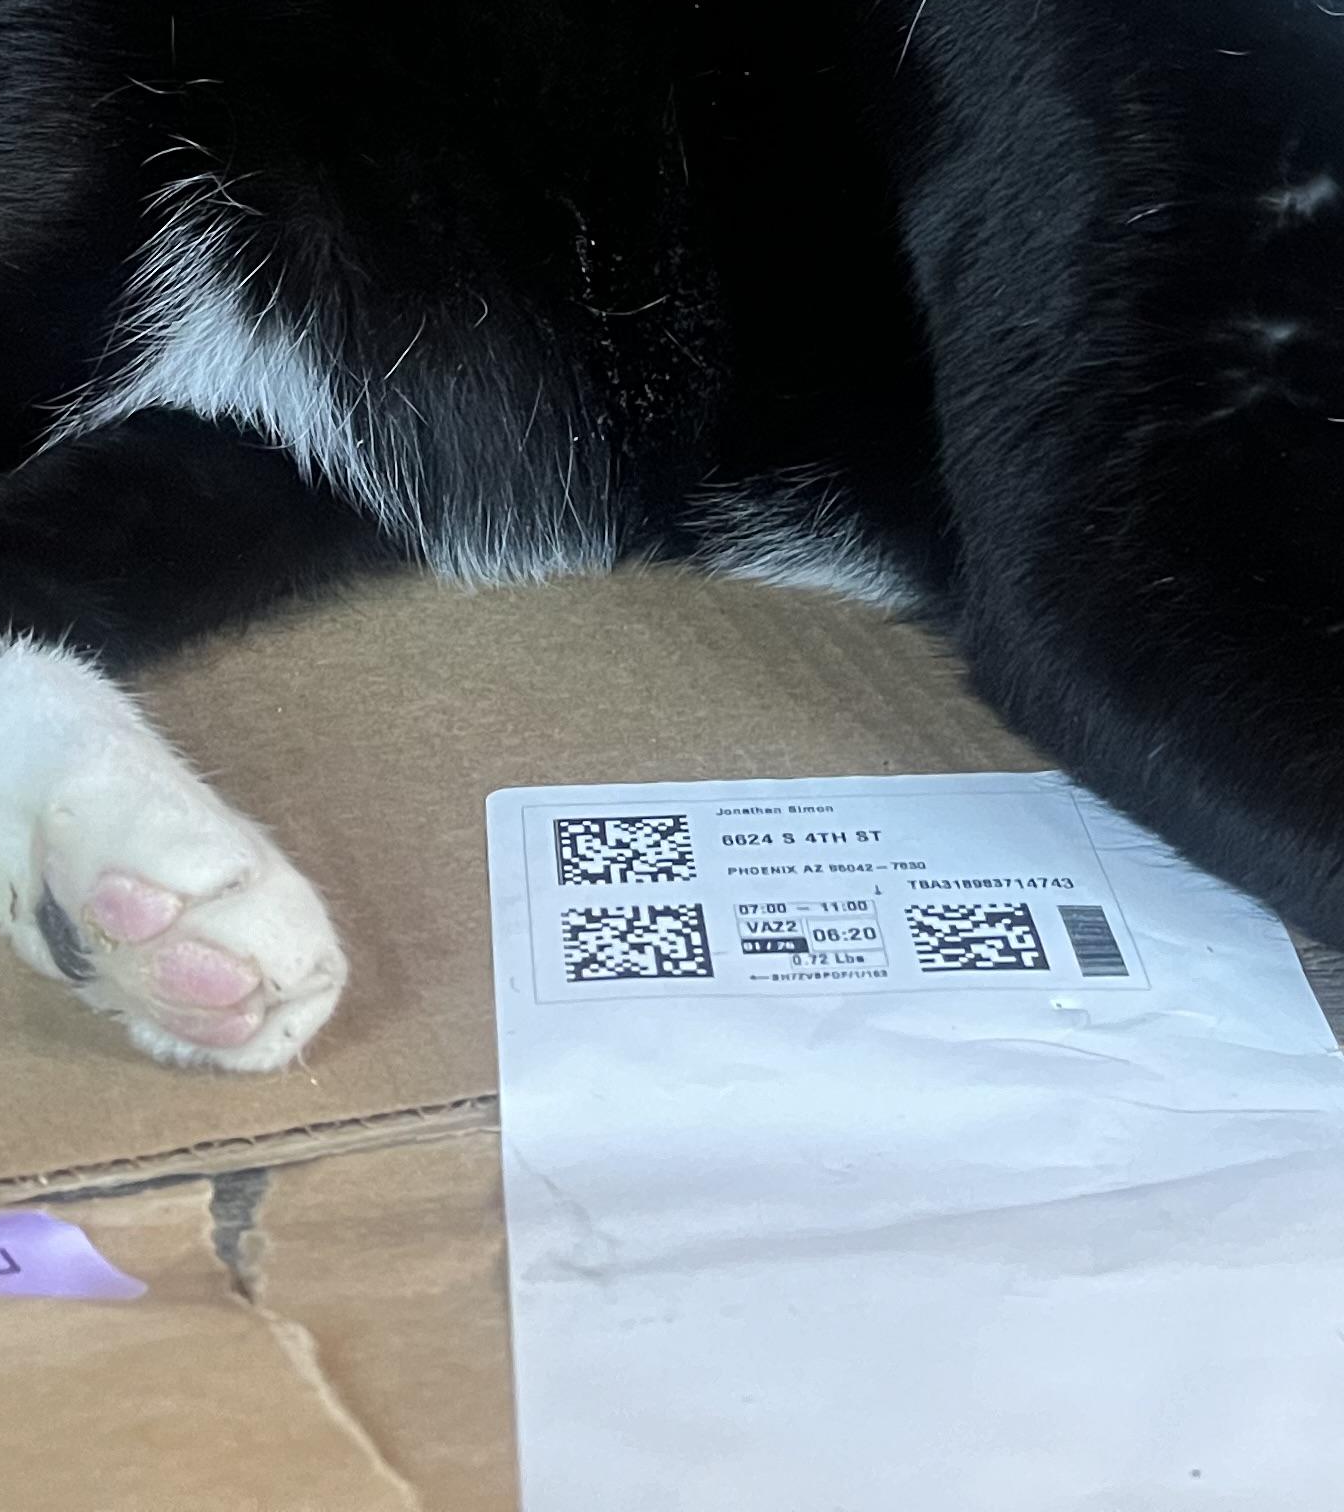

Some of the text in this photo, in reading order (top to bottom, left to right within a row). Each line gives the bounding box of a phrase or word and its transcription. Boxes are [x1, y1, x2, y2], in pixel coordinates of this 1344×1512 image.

[788, 805, 834, 814] Simon
[722, 830, 882, 846] 6624 S 4TH ST
[727, 865, 798, 876] PHOENIX
[803, 864, 824, 874] AZ
[738, 902, 788, 916] 07:00
[822, 899, 869, 913] 11:00
[745, 920, 799, 934] VAZ2
[812, 926, 878, 943] 06:20
[792, 952, 830, 966] 0.72
